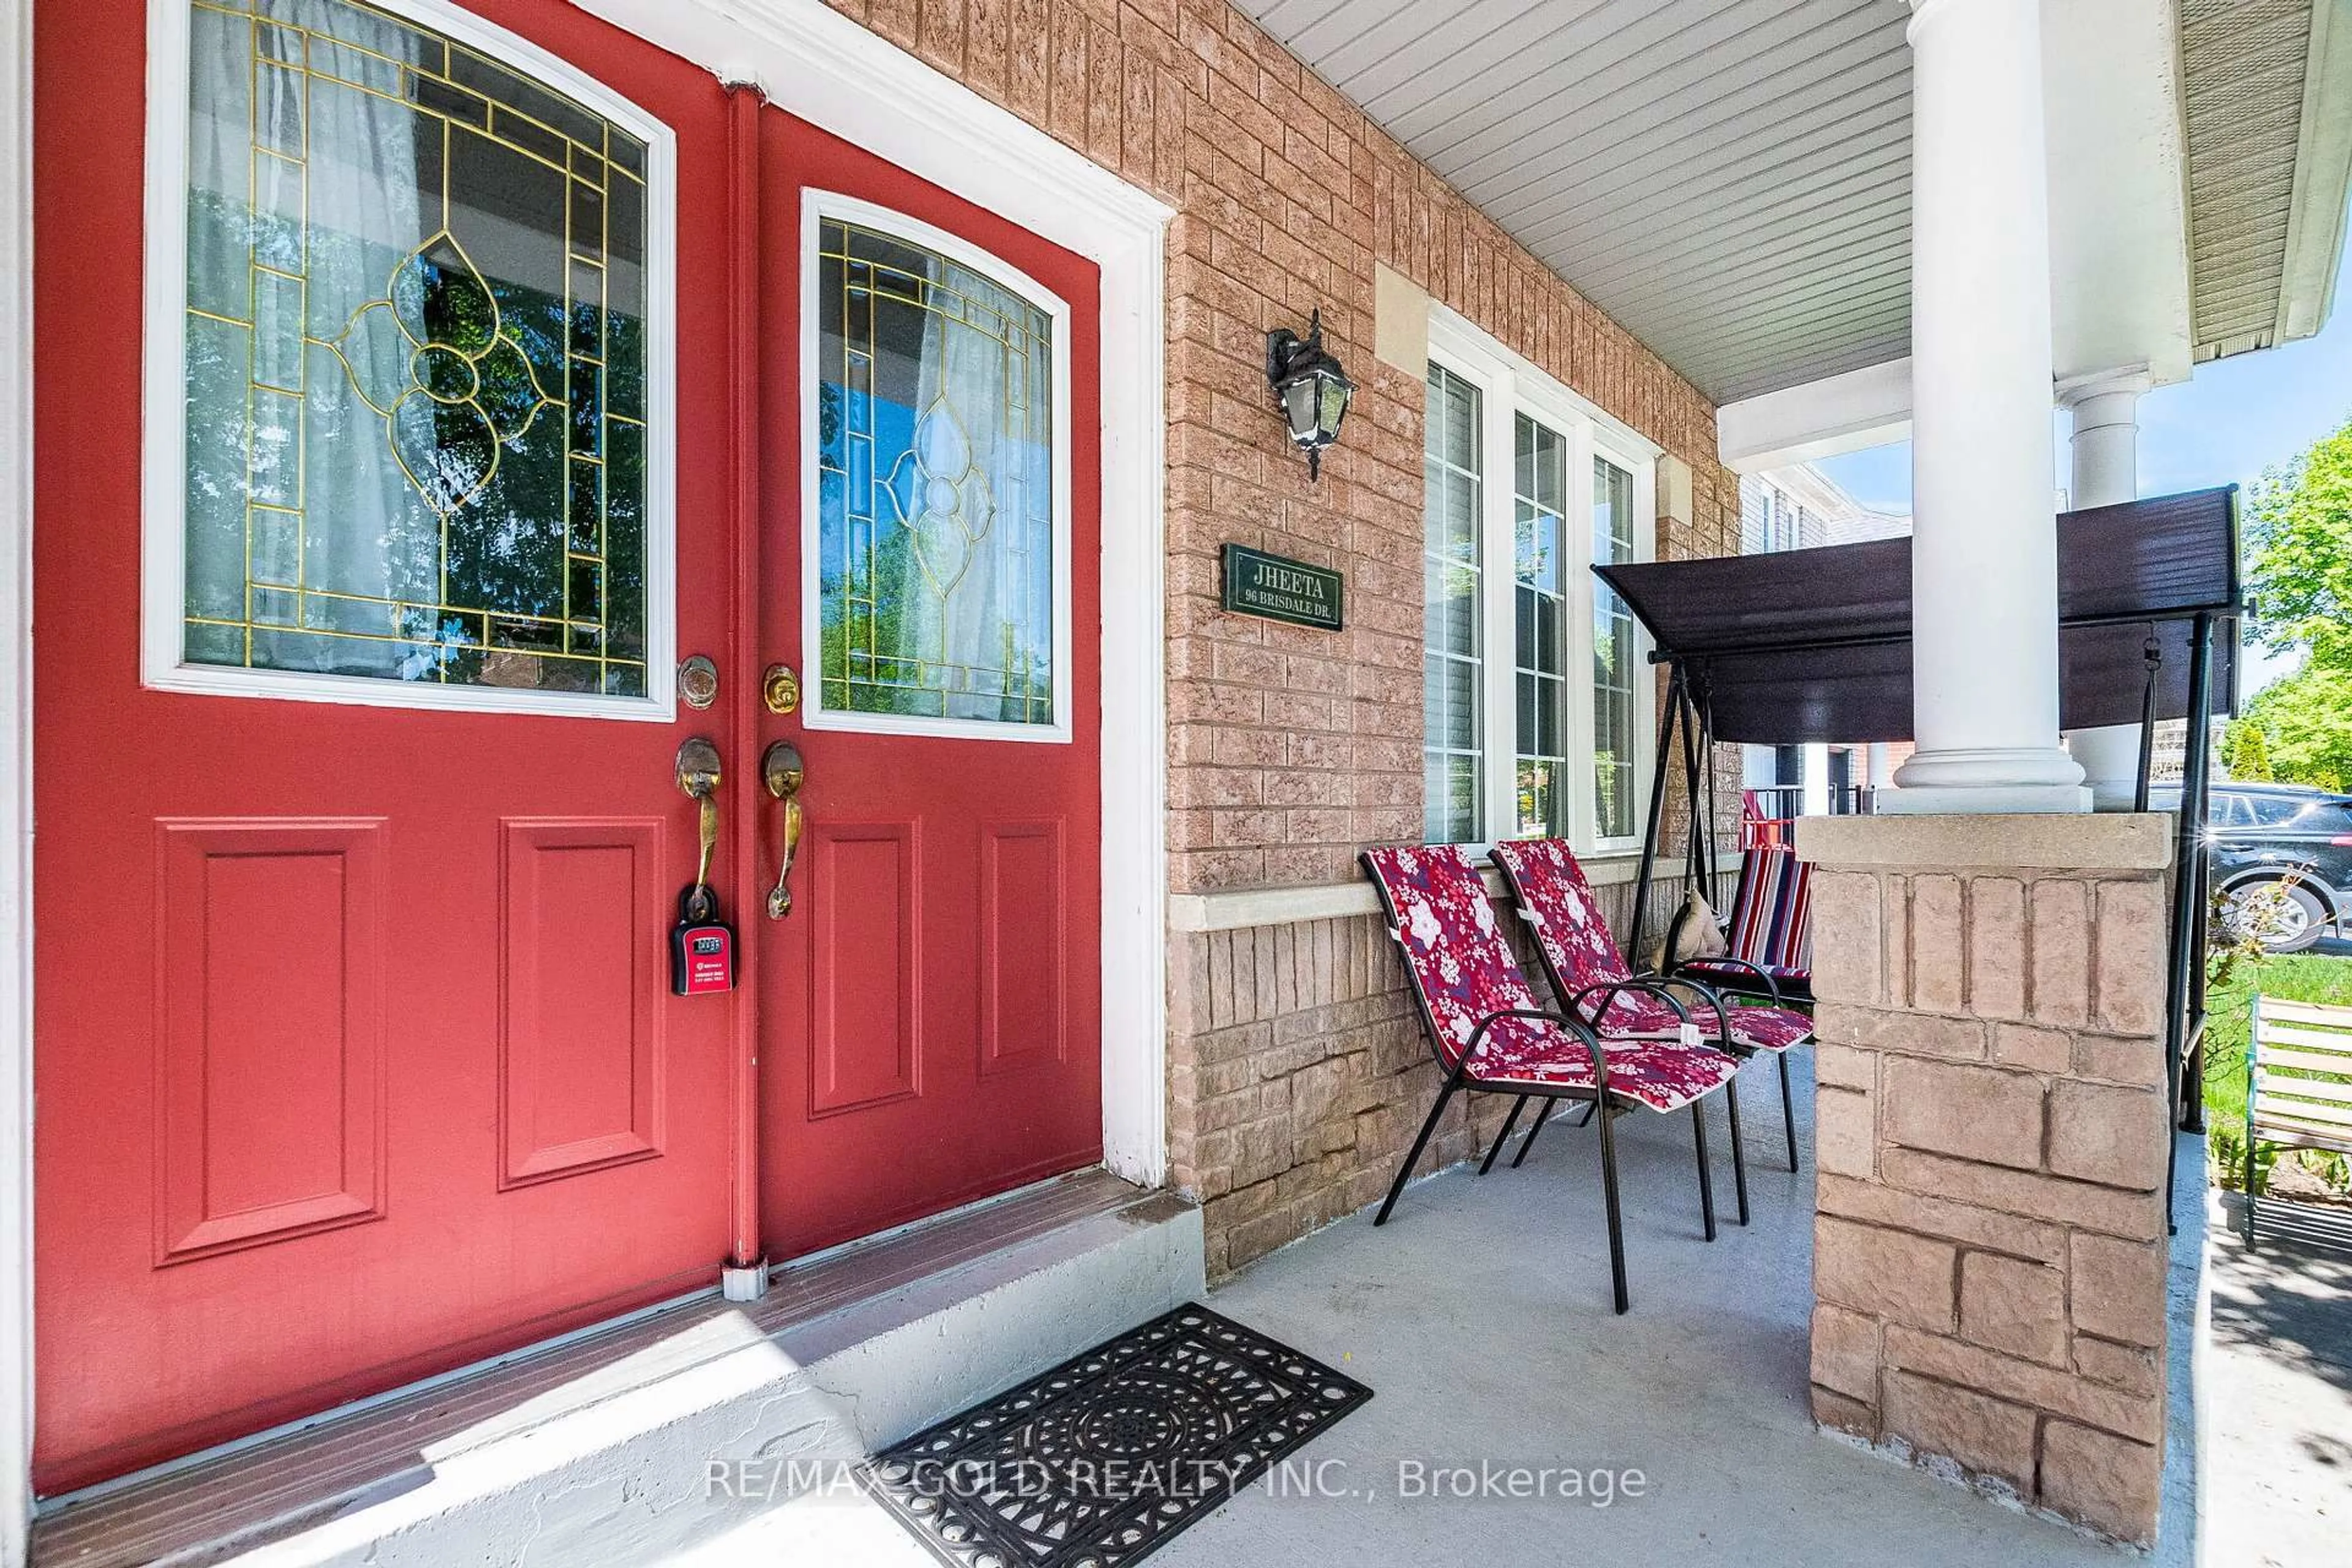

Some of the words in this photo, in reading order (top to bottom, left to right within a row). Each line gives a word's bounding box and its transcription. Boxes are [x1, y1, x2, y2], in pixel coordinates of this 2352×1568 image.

[1254, 563, 1324, 599] JHEETA
[1245, 589, 1257, 601] 96
[1260, 591, 1313, 614] BRISDALE
[1314, 603, 1332, 619] DR.
